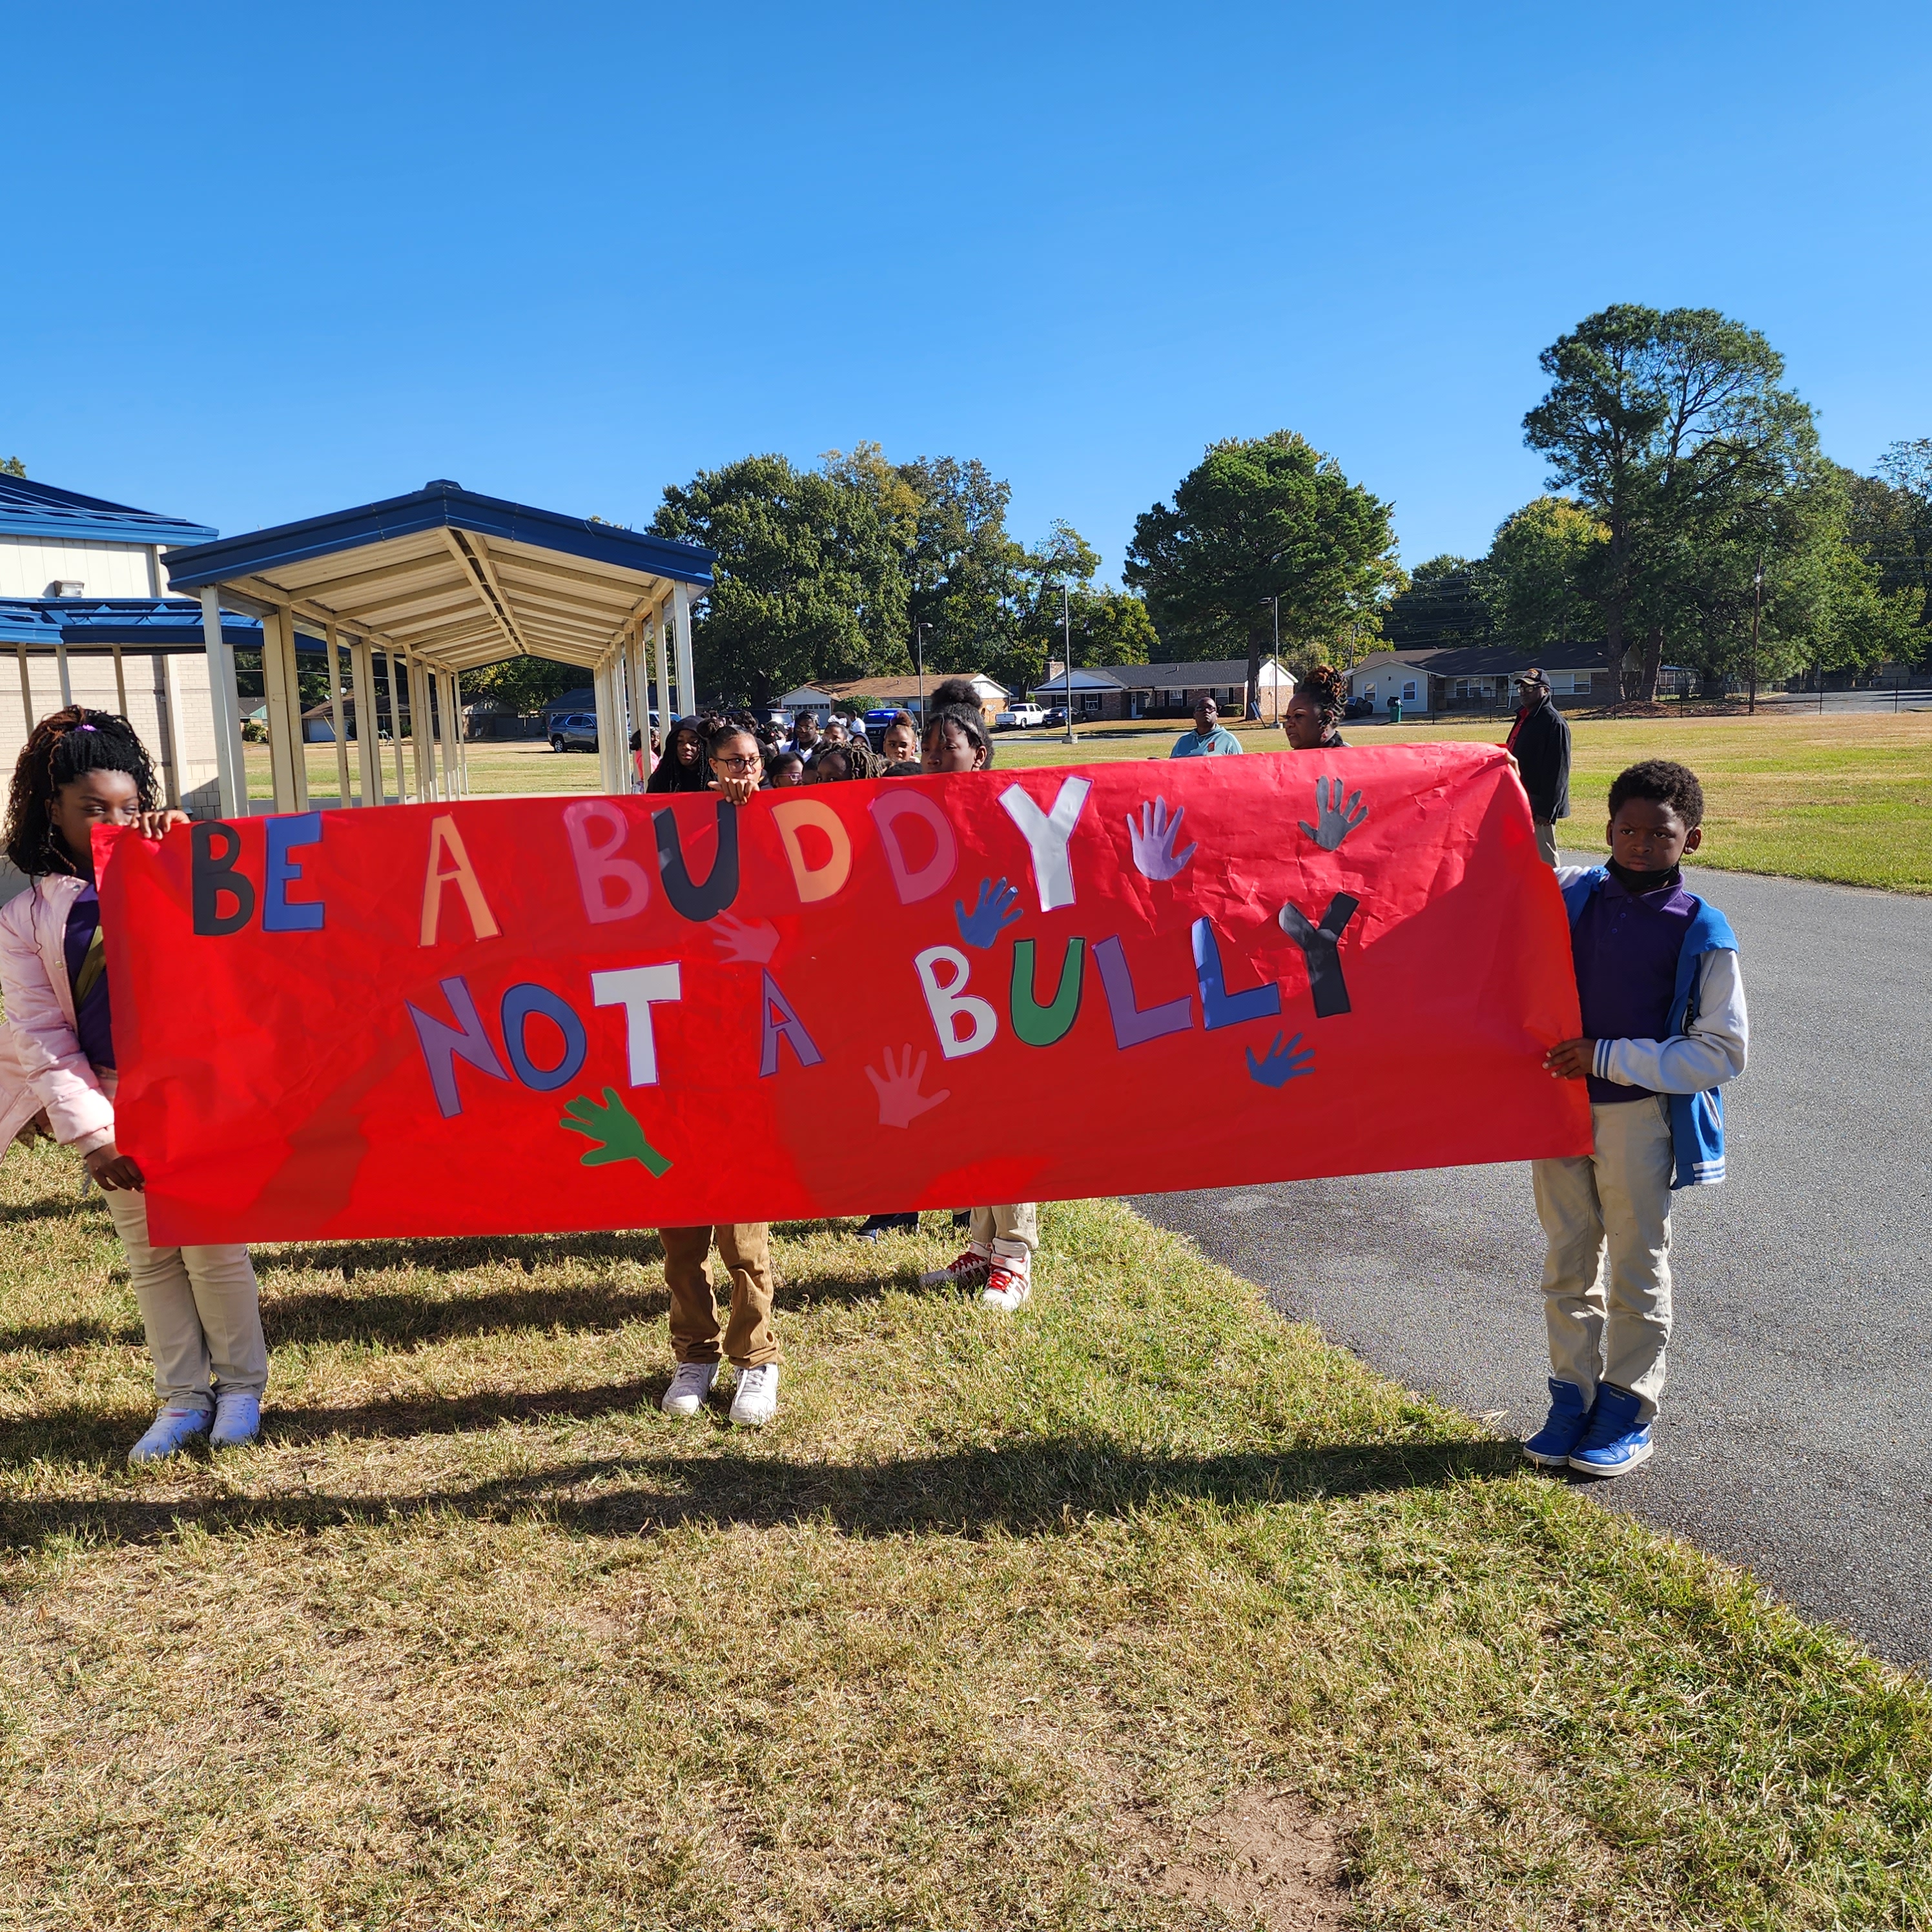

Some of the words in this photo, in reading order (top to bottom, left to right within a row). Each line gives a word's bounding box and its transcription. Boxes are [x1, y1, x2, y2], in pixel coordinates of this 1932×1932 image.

[190, 812, 325, 936] BE
[418, 812, 503, 948] A
[562, 776, 1094, 925] BUDDY
[405, 961, 682, 1118] NOT
[758, 969, 825, 1079] A
[912, 892, 1360, 1061] BULLY
